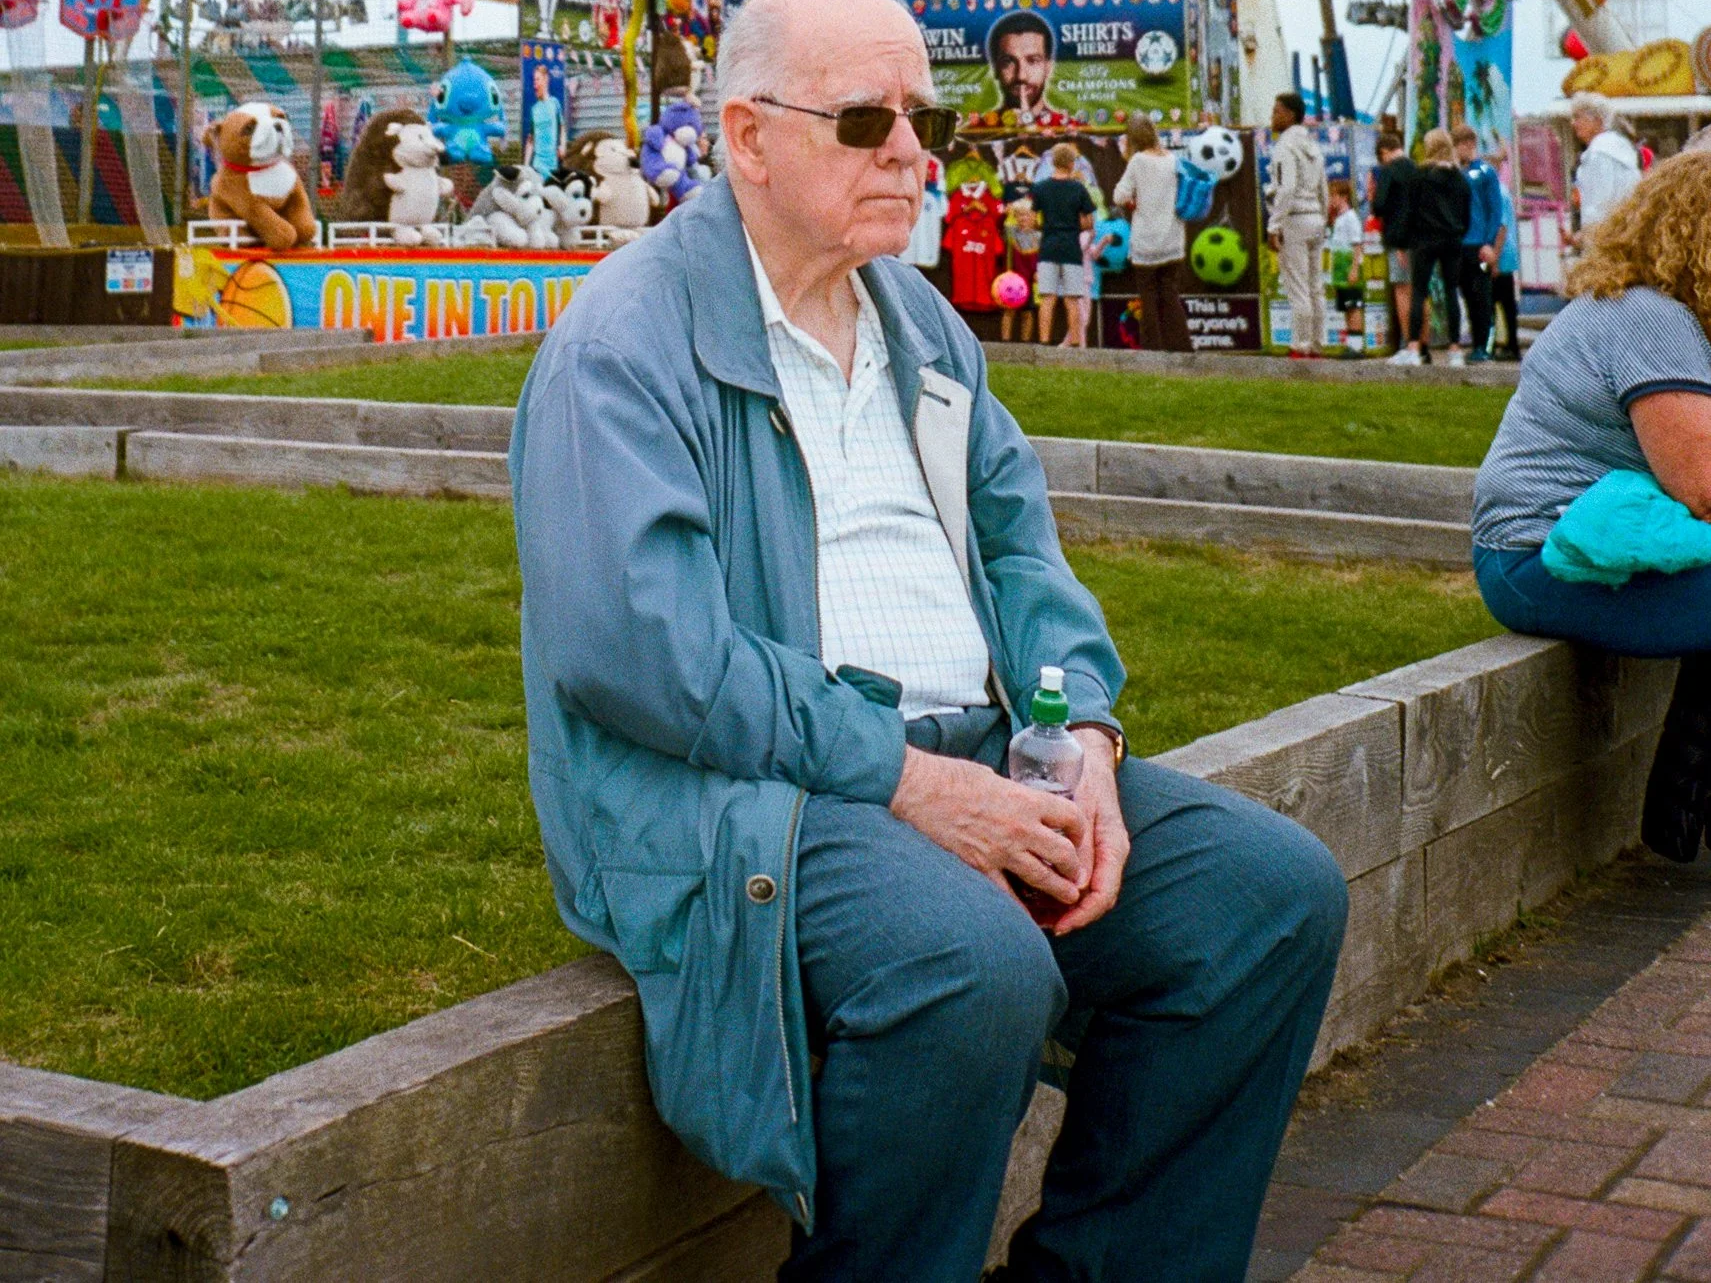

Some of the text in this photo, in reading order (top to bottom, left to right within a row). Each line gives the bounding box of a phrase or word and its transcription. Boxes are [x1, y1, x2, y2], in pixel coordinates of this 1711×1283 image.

[923, 28, 965, 46] WIN
[1060, 21, 1134, 43] SHIRTS
[1076, 41, 1117, 56] HERE
[1057, 78, 1137, 92] CHAMPIONS
[321, 269, 417, 344] ONE
[424, 277, 473, 340] IN
[480, 277, 537, 335] TO
[1185, 298, 1230, 314] This is
[1187, 317, 1247, 333] eryone's
